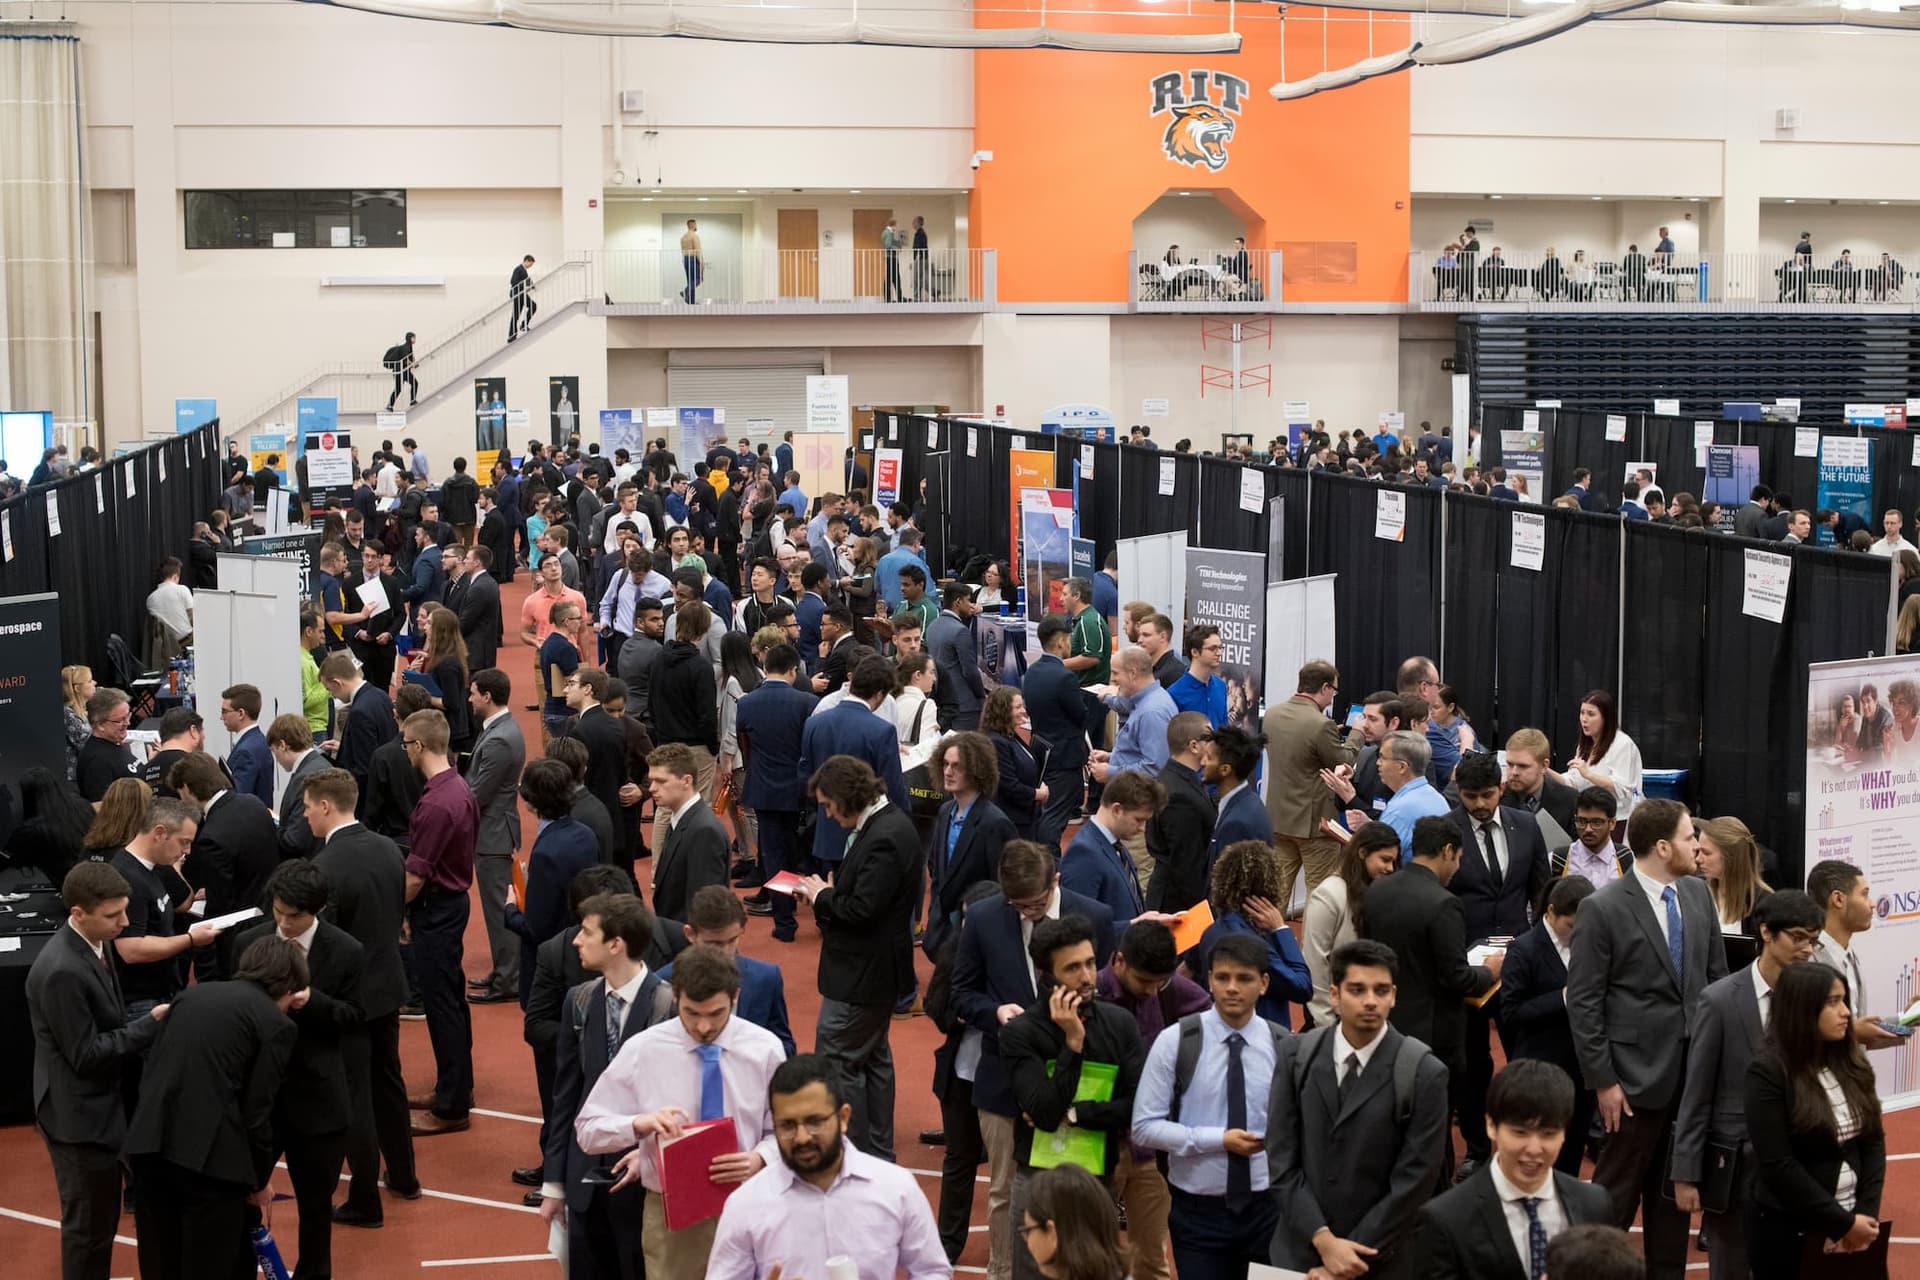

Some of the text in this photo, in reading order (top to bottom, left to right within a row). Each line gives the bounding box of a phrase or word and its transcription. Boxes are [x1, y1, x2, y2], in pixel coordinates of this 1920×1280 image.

[1151, 70, 1248, 115] RIT
[1820, 472, 1870, 483] THE FUTURE
[262, 541, 285, 551] Named
[299, 538, 305, 546] of
[1197, 599, 1250, 620] CHALLENGE
[1821, 780, 1834, 794] It's
[1834, 780, 1846, 792] not
[1847, 777, 1860, 792] only
[1861, 770, 1891, 790] WHAT
[1892, 774, 1905, 786] you
[1871, 791, 1896, 810] WHY
[1897, 795, 1910, 807] you
